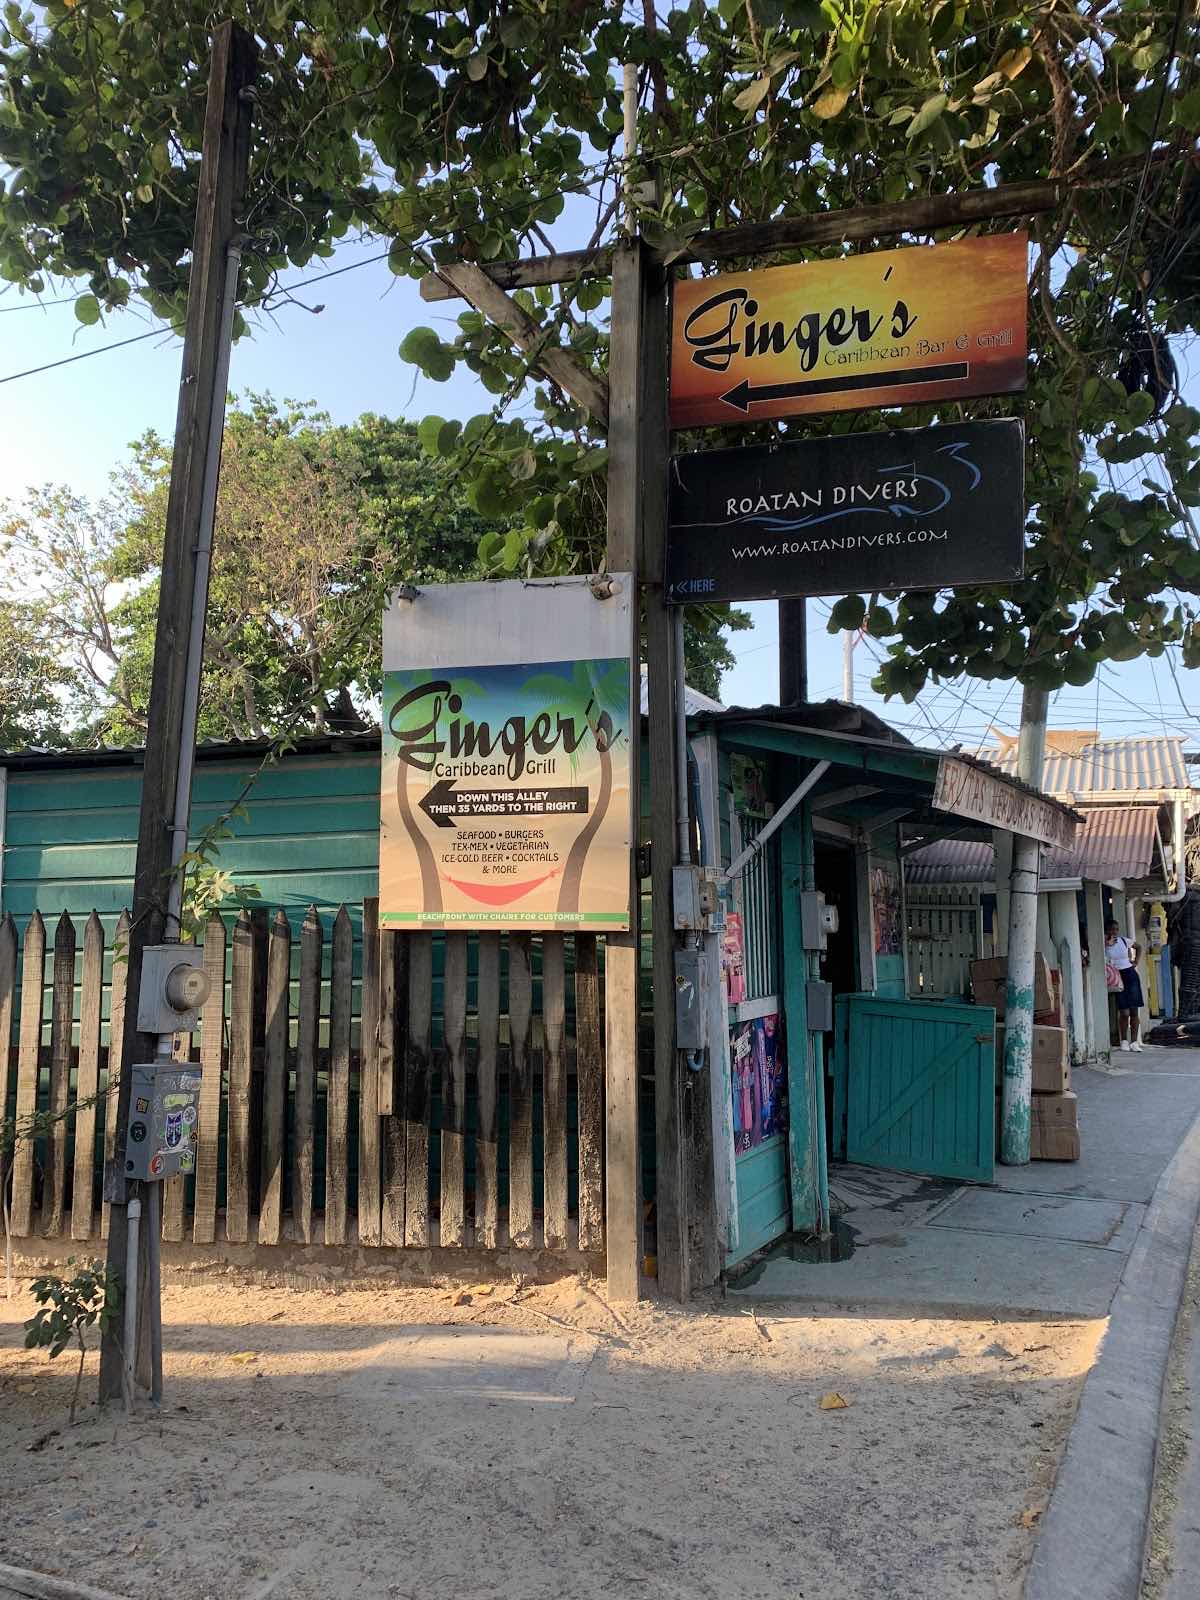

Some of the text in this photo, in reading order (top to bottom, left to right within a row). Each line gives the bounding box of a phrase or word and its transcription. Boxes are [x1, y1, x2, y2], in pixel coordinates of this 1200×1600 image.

[684, 266, 917, 372] Ginger's
[824, 345, 911, 366] Caribbean
[917, 339, 946, 356] Bar
[976, 327, 1013, 348] Grill
[726, 478, 921, 516] ROATAN DIVERS
[732, 529, 949, 560] WWW.ROATANDIVERS.COM
[389, 680, 623, 782] Ginger's
[435, 759, 556, 777] Caribbean Grill
[457, 792, 549, 803] DOWN THIS ALLEY
[429, 801, 577, 814] THEN 35 YARDS TO THE RIGHT
[457, 830, 544, 840] SEAFOOD BURGERS
[452, 841, 549, 851] TEX-MEX VEGETARIAN
[441, 852, 559, 863] ICE-COLD BEER COCKTAILS
[482, 865, 518, 874] & MORE
[417, 913, 585, 921] BEACHFRONT WITH CHAIRS FOR CUSTOMERS
